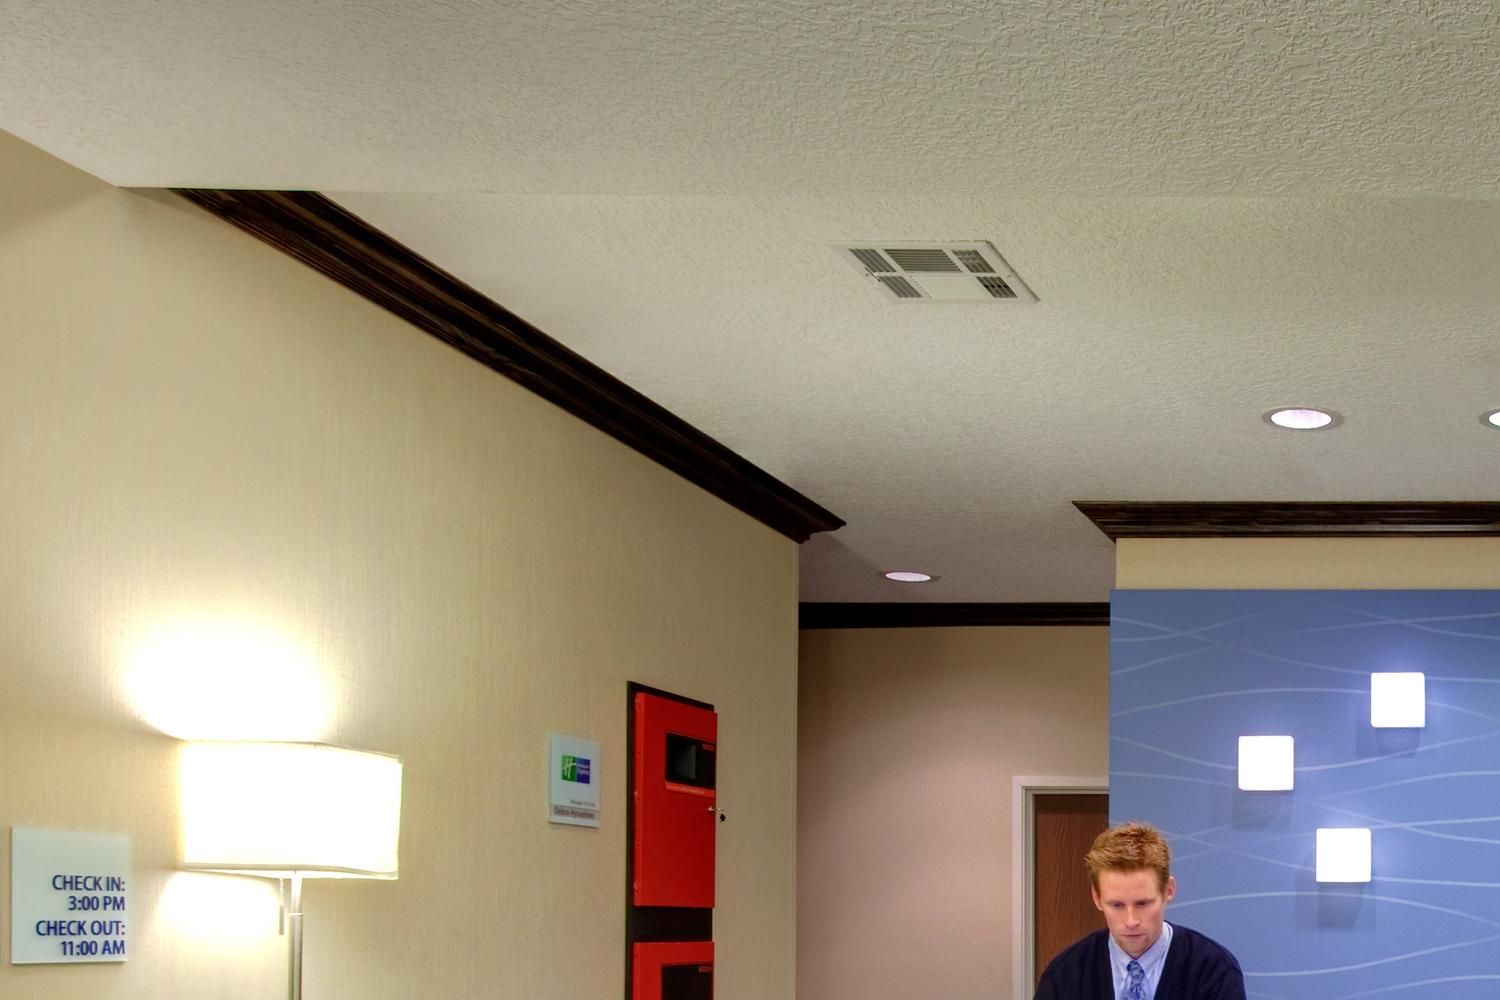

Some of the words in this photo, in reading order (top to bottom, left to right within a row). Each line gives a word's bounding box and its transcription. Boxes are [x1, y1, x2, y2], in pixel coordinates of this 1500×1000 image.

[52, 874, 103, 892] CHECK
[106, 876, 126, 892] IN:
[68, 895, 100, 911] 3:00
[103, 896, 126, 911] PM
[36, 920, 87, 936] CHECK
[90, 920, 126, 936] OUT:
[61, 940, 98, 956] 11:00
[102, 940, 126, 955] AM
